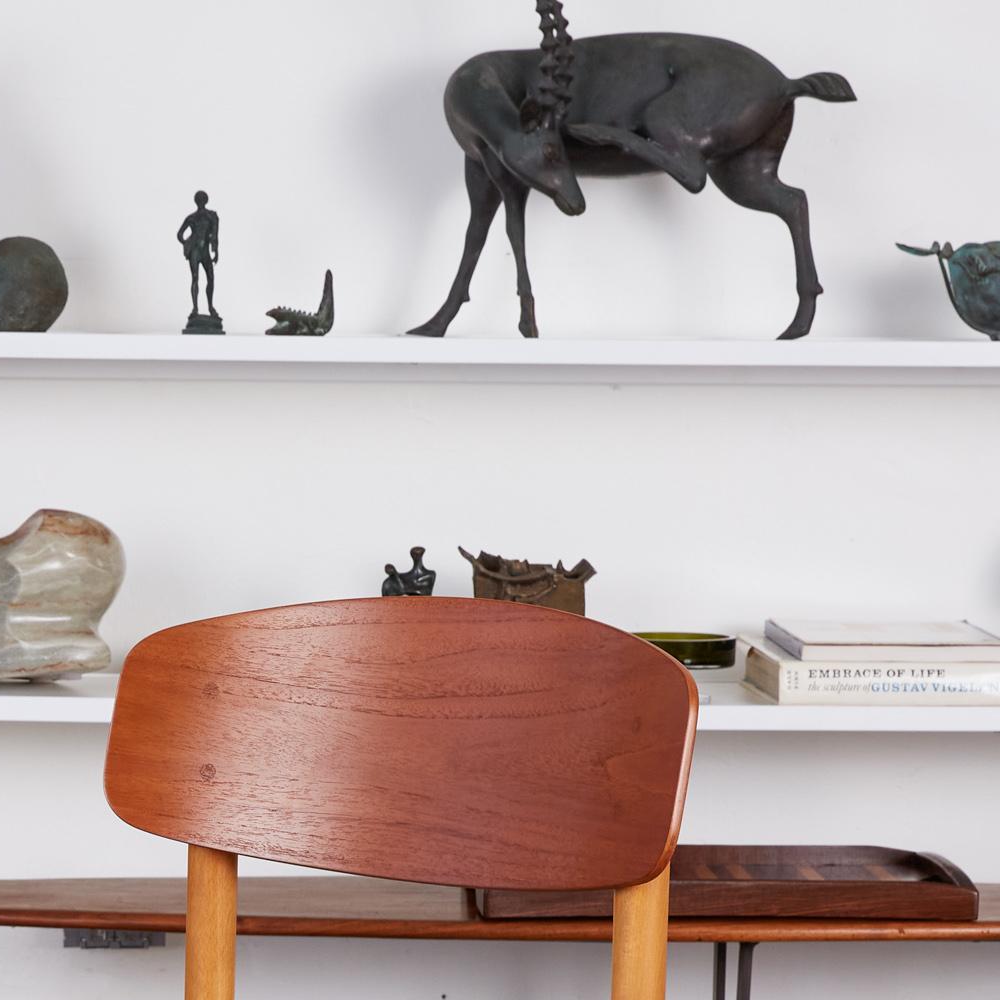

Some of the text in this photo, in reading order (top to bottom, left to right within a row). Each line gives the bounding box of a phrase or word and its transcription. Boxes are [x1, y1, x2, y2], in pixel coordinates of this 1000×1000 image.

[808, 668, 946, 679] EMBRACE OF LIFE
[807, 681, 820, 692] the
[823, 681, 861, 694] sculpture
[862, 681, 872, 693] of
[871, 682, 928, 693] GUSTAV
